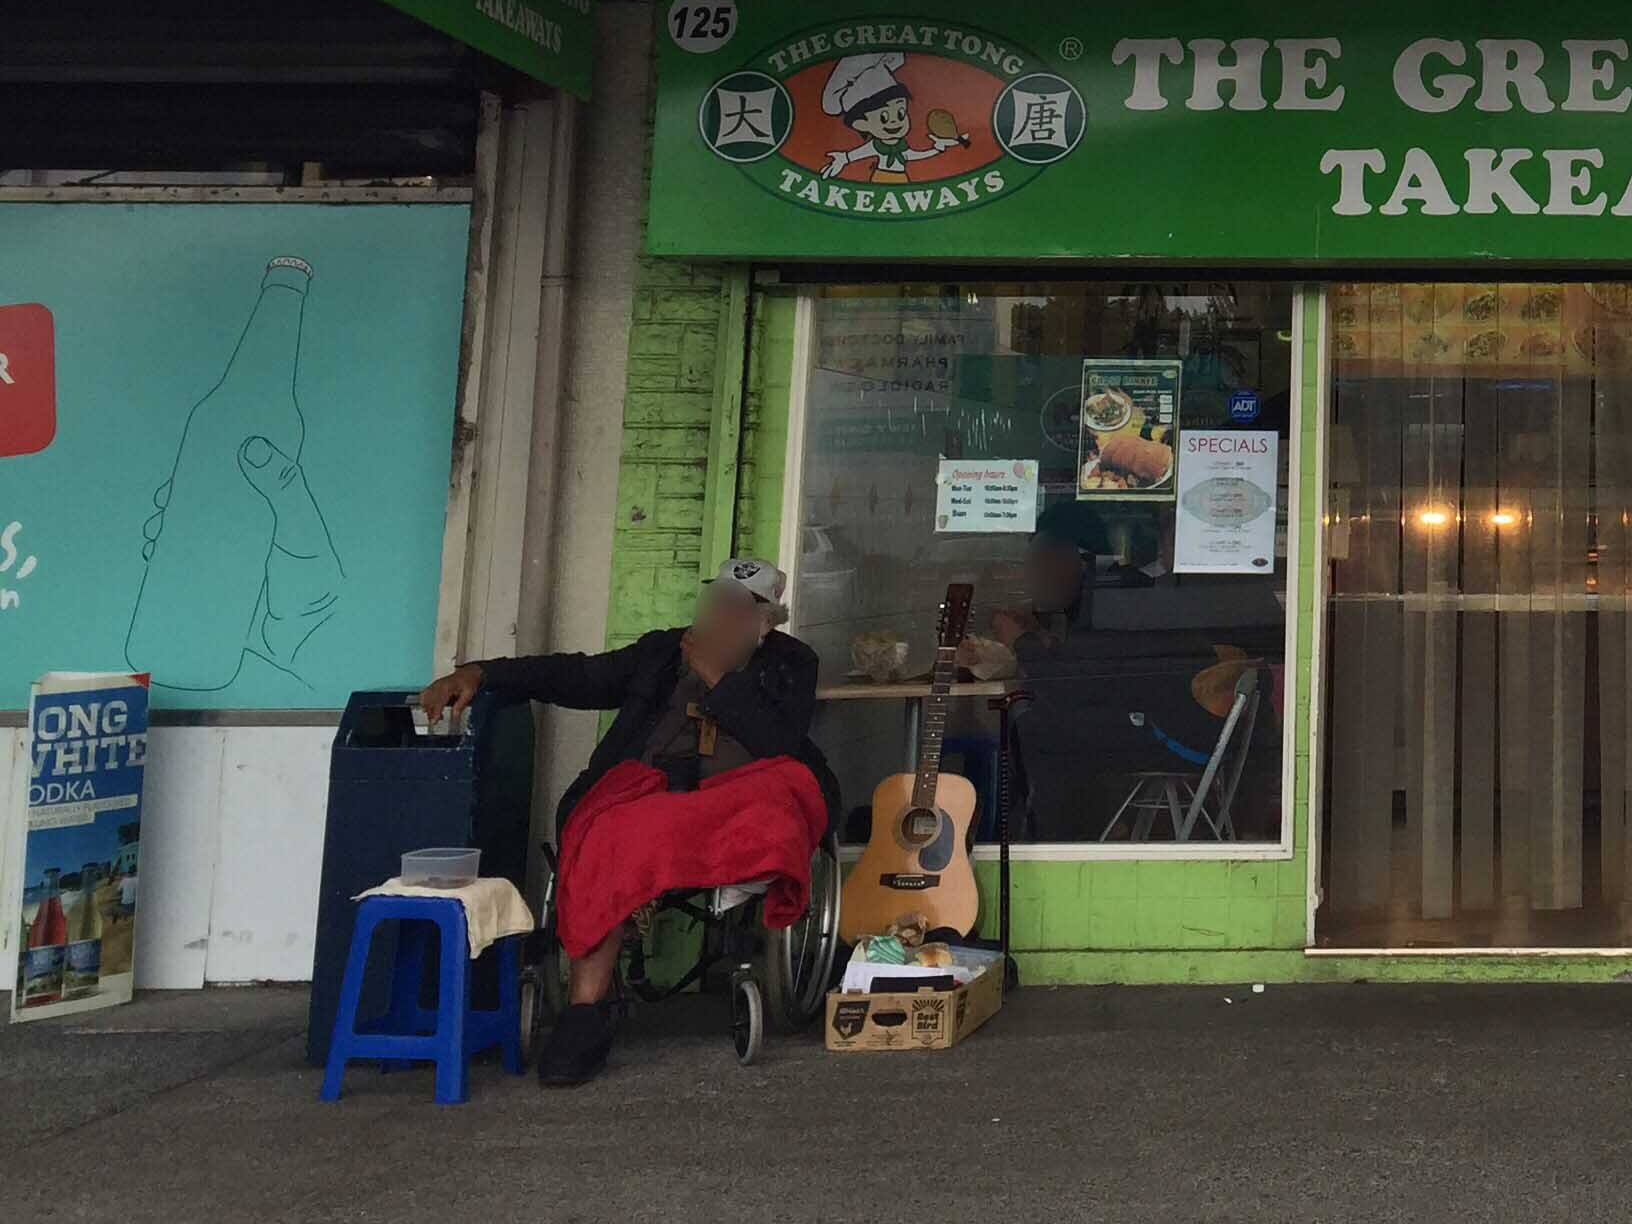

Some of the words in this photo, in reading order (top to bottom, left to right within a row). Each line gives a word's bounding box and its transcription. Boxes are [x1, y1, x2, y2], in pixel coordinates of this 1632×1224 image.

[673, 7, 732, 39] 125
[768, 32, 829, 73] THE
[833, 24, 938, 49] GREAT
[944, 28, 1026, 76] TONG
[1112, 37, 1346, 113] THE
[725, 95, 771, 139] 大
[1012, 94, 1063, 144] 唐
[779, 169, 1005, 214] TAKEAWAYS
[1233, 399, 1256, 412] ADT
[1188, 437, 1268, 454] SPECIALS
